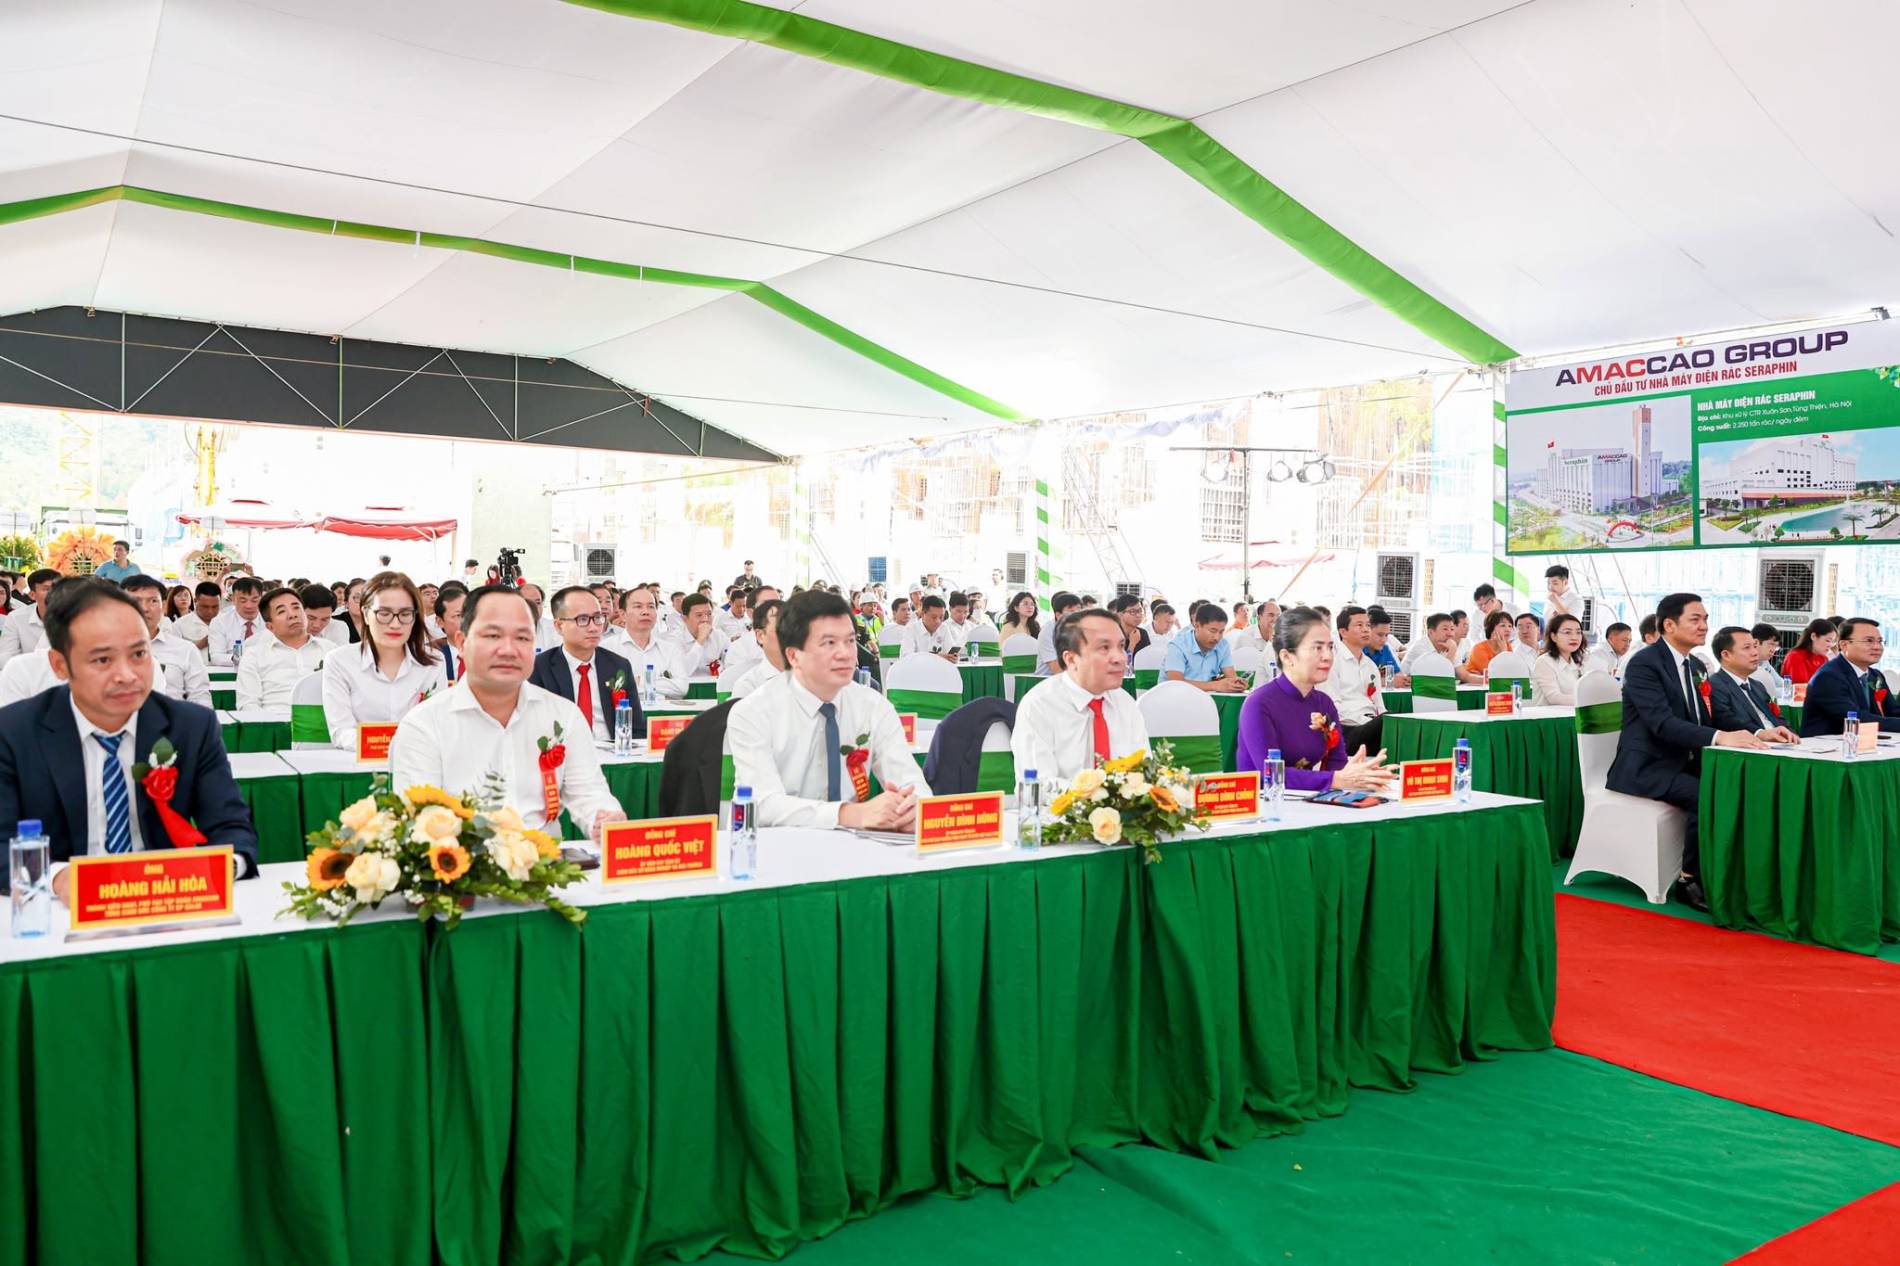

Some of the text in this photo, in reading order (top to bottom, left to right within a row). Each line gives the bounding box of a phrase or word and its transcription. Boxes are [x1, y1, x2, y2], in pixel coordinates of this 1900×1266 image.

[1556, 331, 1848, 386] AMACCAO GROUP
[1594, 361, 1798, 396] CHỦ ĐẦU TƯ NHÀ MÁY ĐIỆN RÁC SERAPHIN
[1697, 390, 1816, 411] NHÀ MÁY ĐIỆN RÁC SERAPHIN
[615, 839, 704, 859] HOÀNG QUỐC VIỆT
[144, 864, 163, 875] ÔNG
[99, 874, 207, 899] HOÀNG HẢI HÒA
